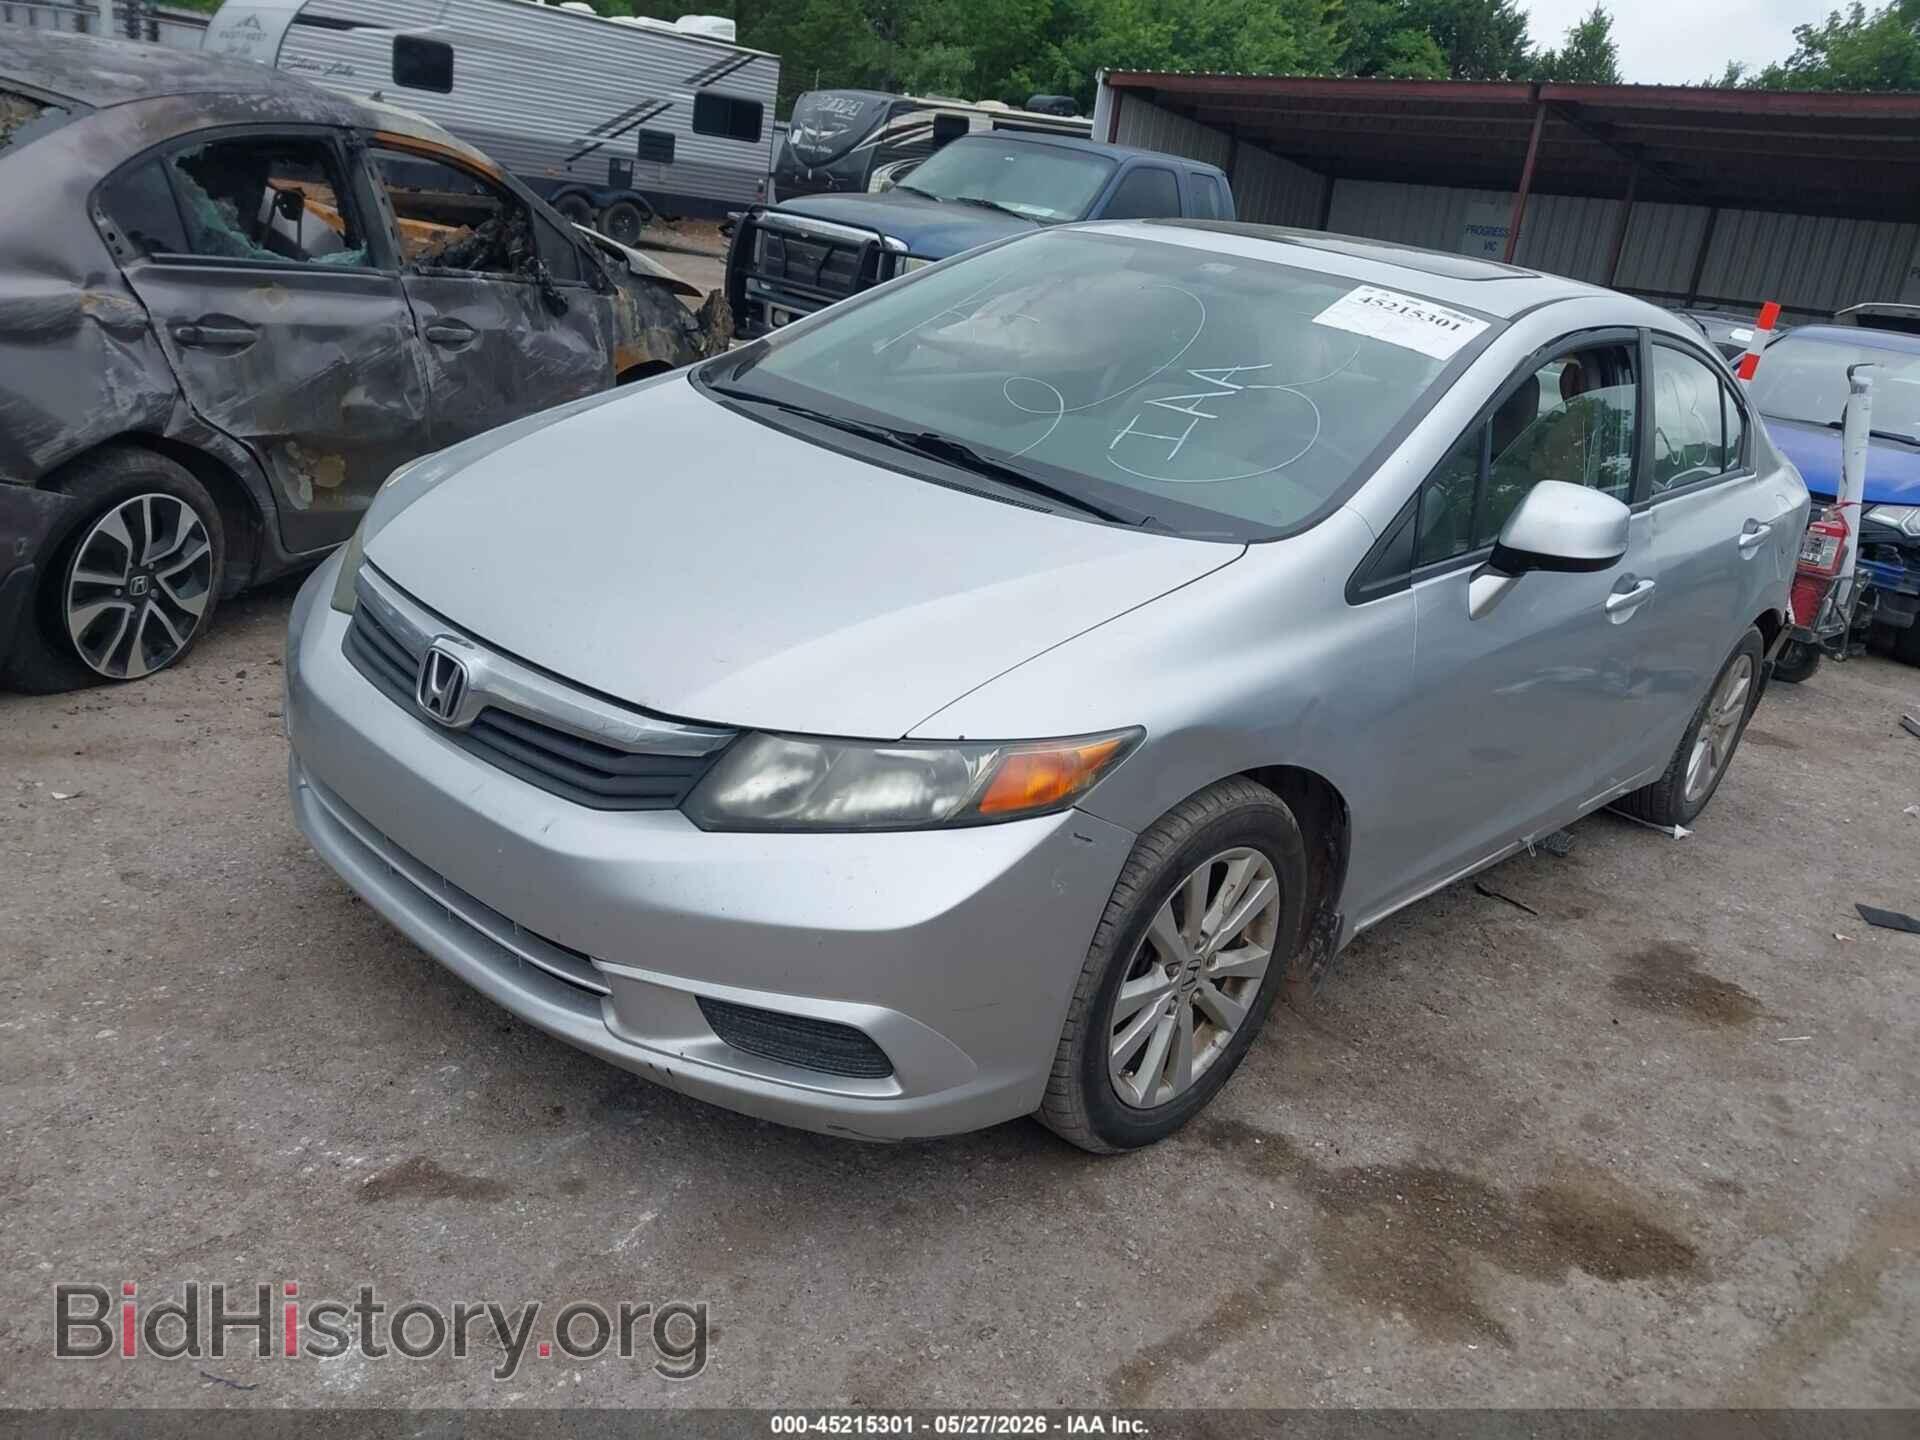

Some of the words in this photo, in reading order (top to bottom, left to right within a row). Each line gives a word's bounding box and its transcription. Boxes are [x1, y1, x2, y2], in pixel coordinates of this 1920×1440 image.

[1464, 224, 1512, 238] PROGRESS
[1359, 295, 1462, 332] 45215301
[1109, 363, 1273, 460] IAA
